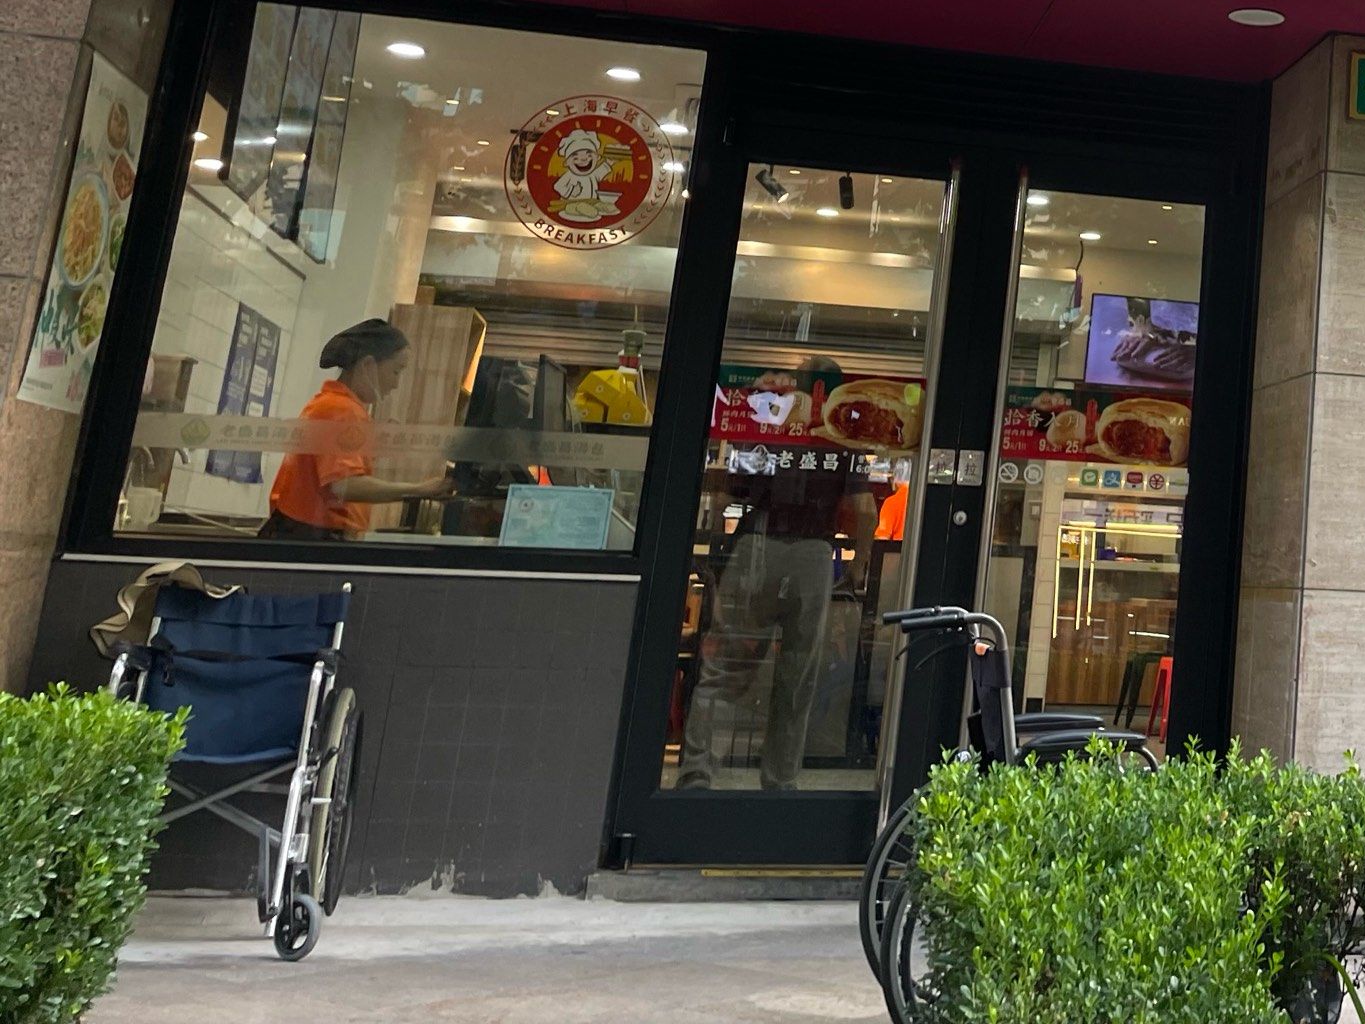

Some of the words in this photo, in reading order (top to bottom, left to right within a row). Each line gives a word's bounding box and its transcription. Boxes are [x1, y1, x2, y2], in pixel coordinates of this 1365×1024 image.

[562, 98, 640, 125] 上海早餐
[533, 217, 628, 245] BREAKFAST
[776, 448, 841, 472] 老盛昌
